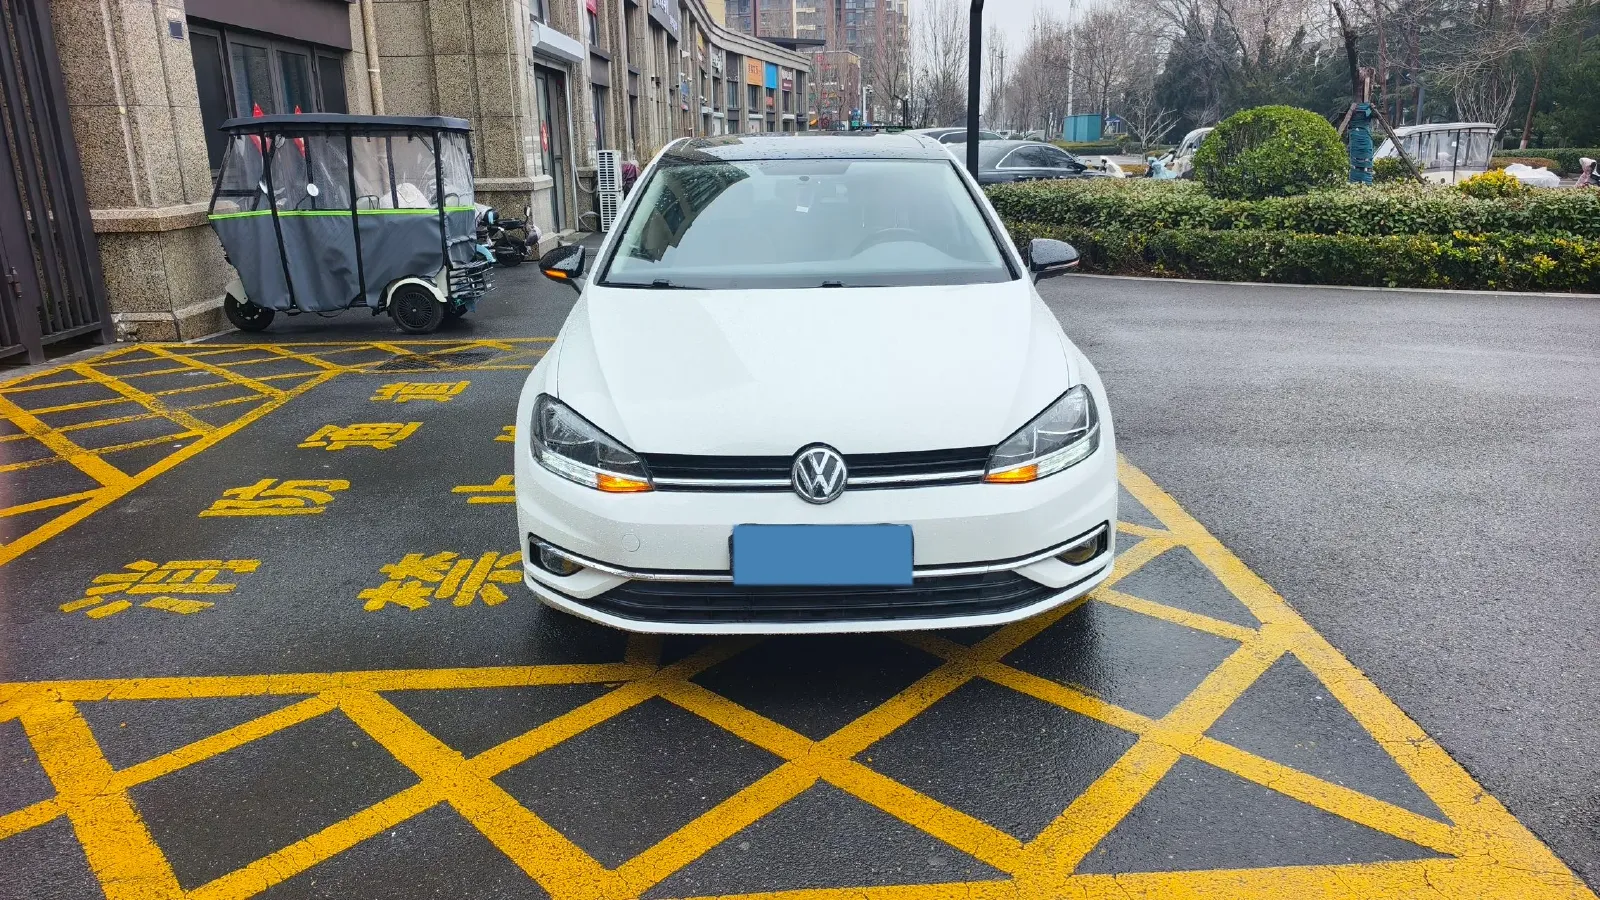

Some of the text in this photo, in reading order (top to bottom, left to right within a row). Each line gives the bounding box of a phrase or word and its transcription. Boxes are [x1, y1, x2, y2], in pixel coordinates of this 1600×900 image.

[60, 381, 470, 619] 消防通道
[797, 446, 847, 500] VW
